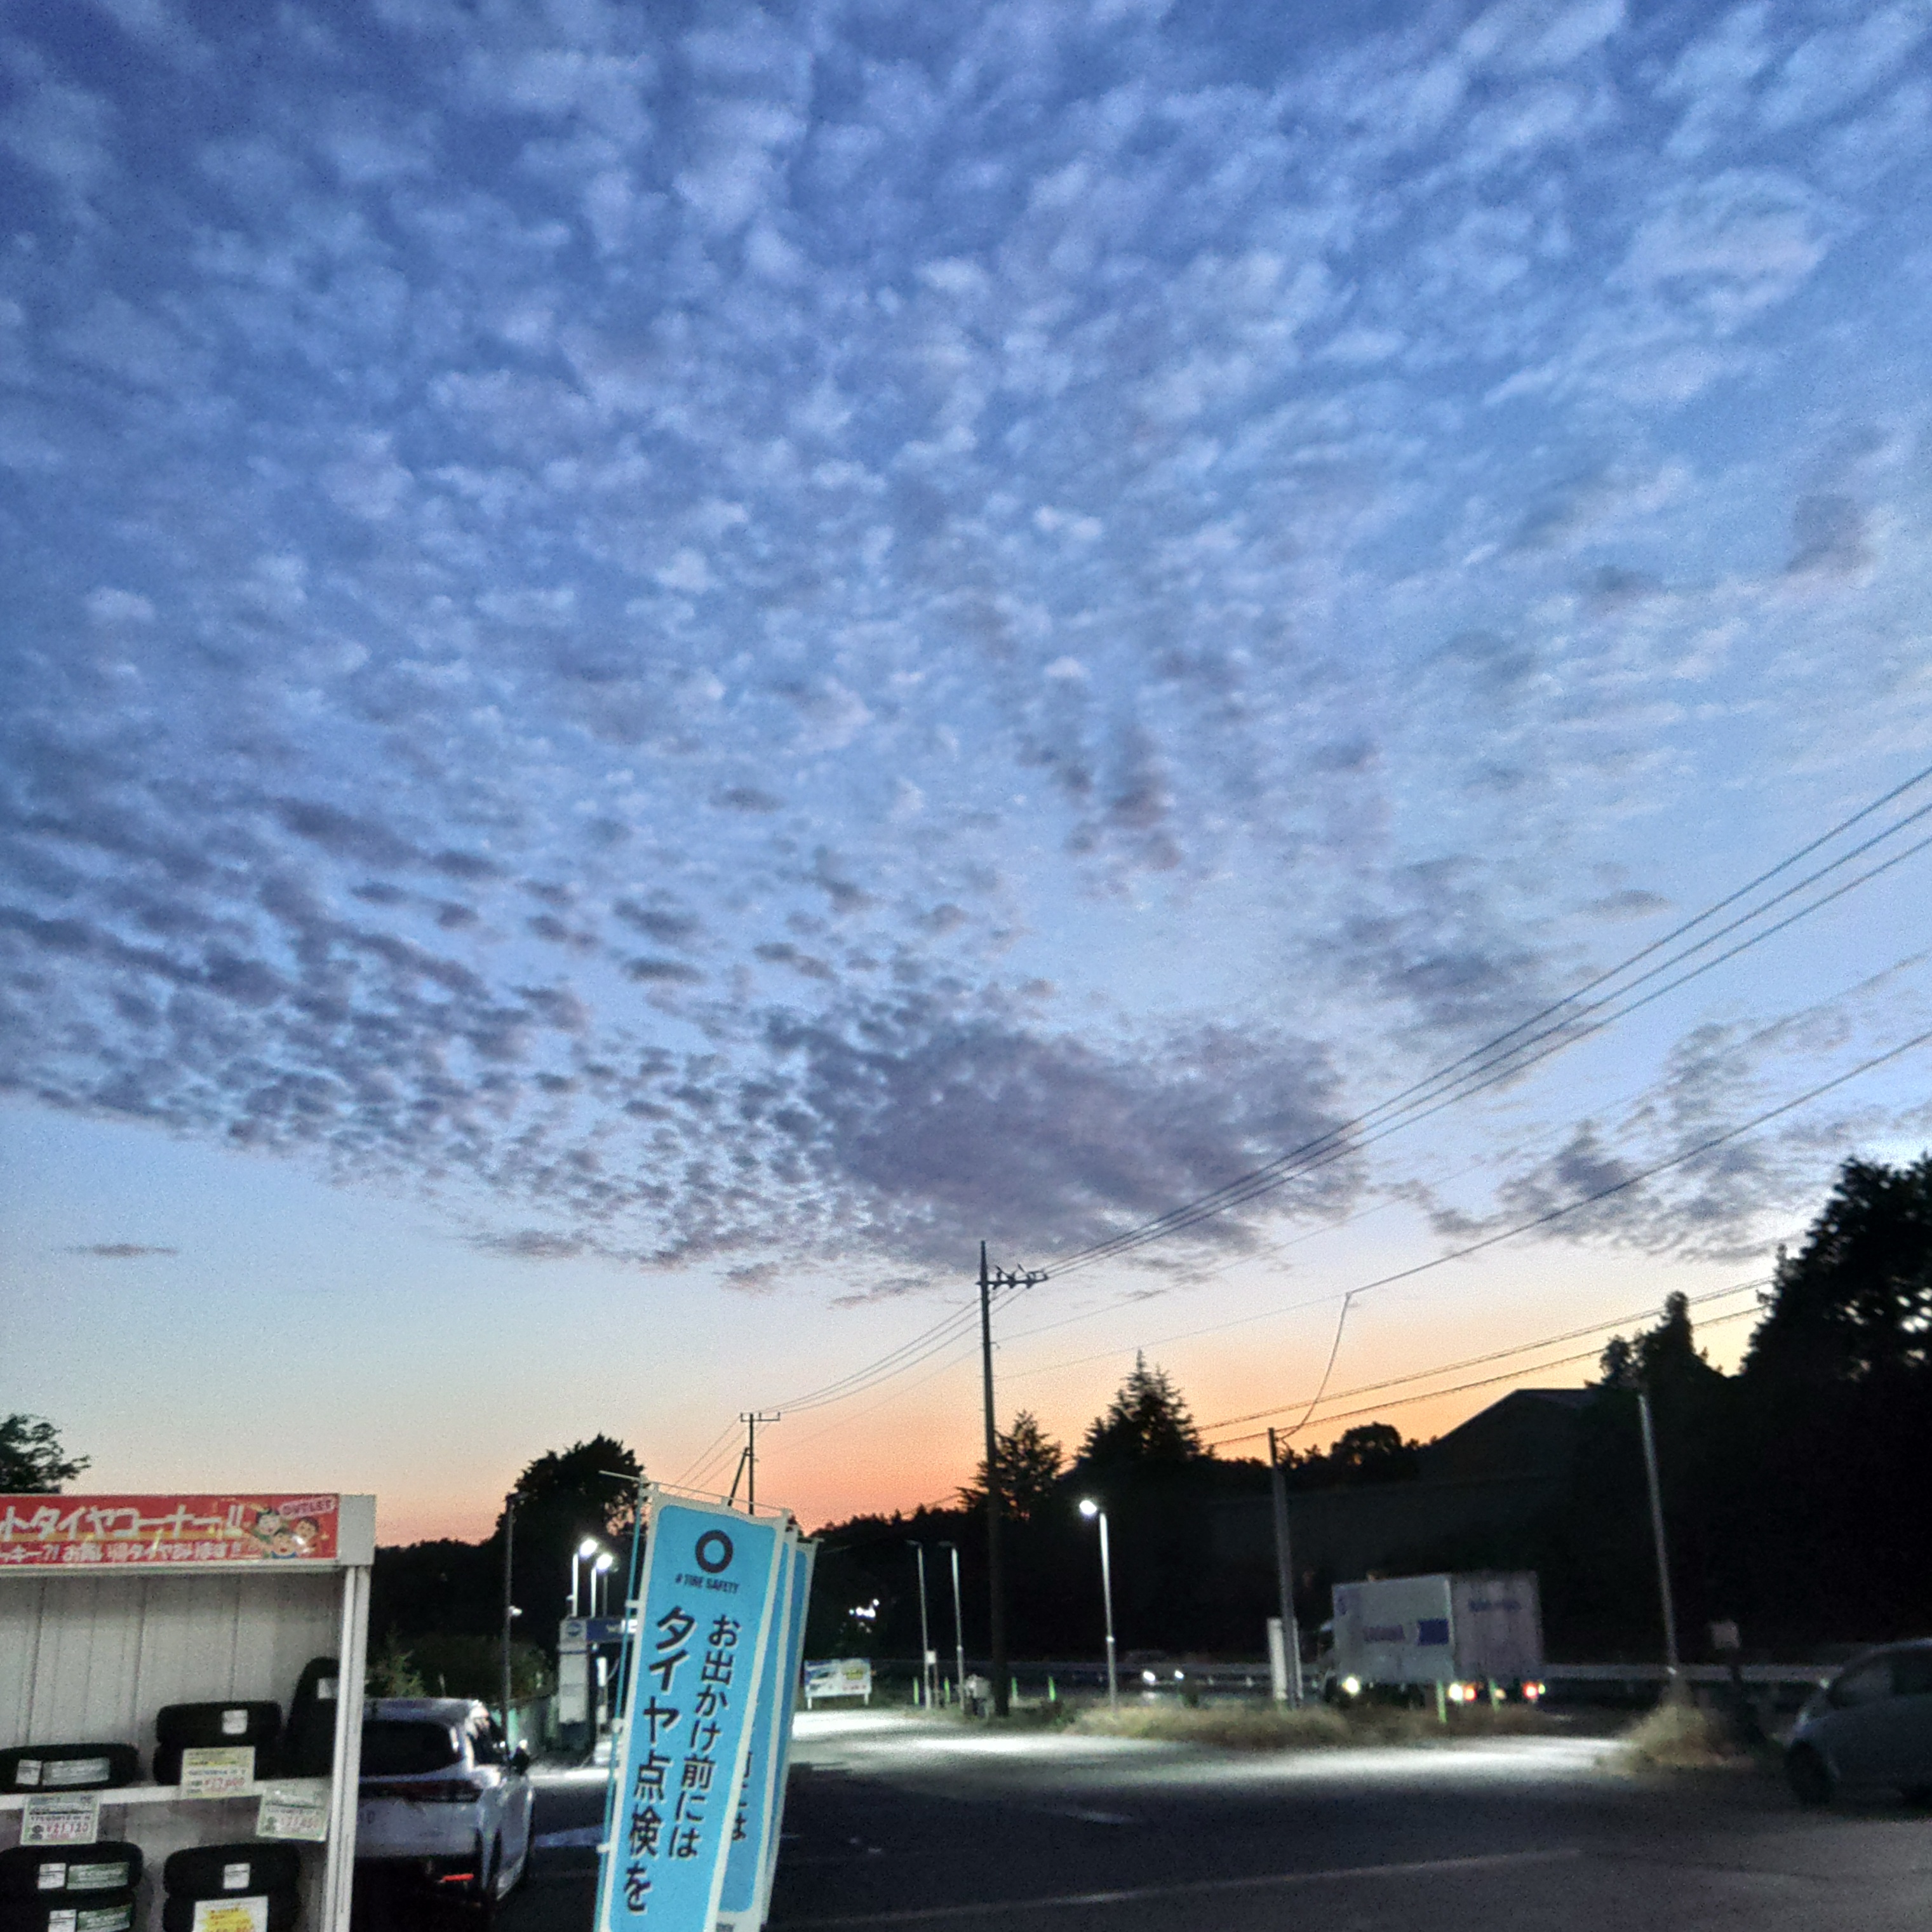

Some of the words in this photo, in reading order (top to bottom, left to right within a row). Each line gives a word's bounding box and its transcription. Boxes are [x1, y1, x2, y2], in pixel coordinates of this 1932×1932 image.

[706, 1578, 740, 1594] SAFETY
[624, 1605, 697, 1912] タイヤ点検を
[669, 1614, 741, 1858] お出かけ前には
